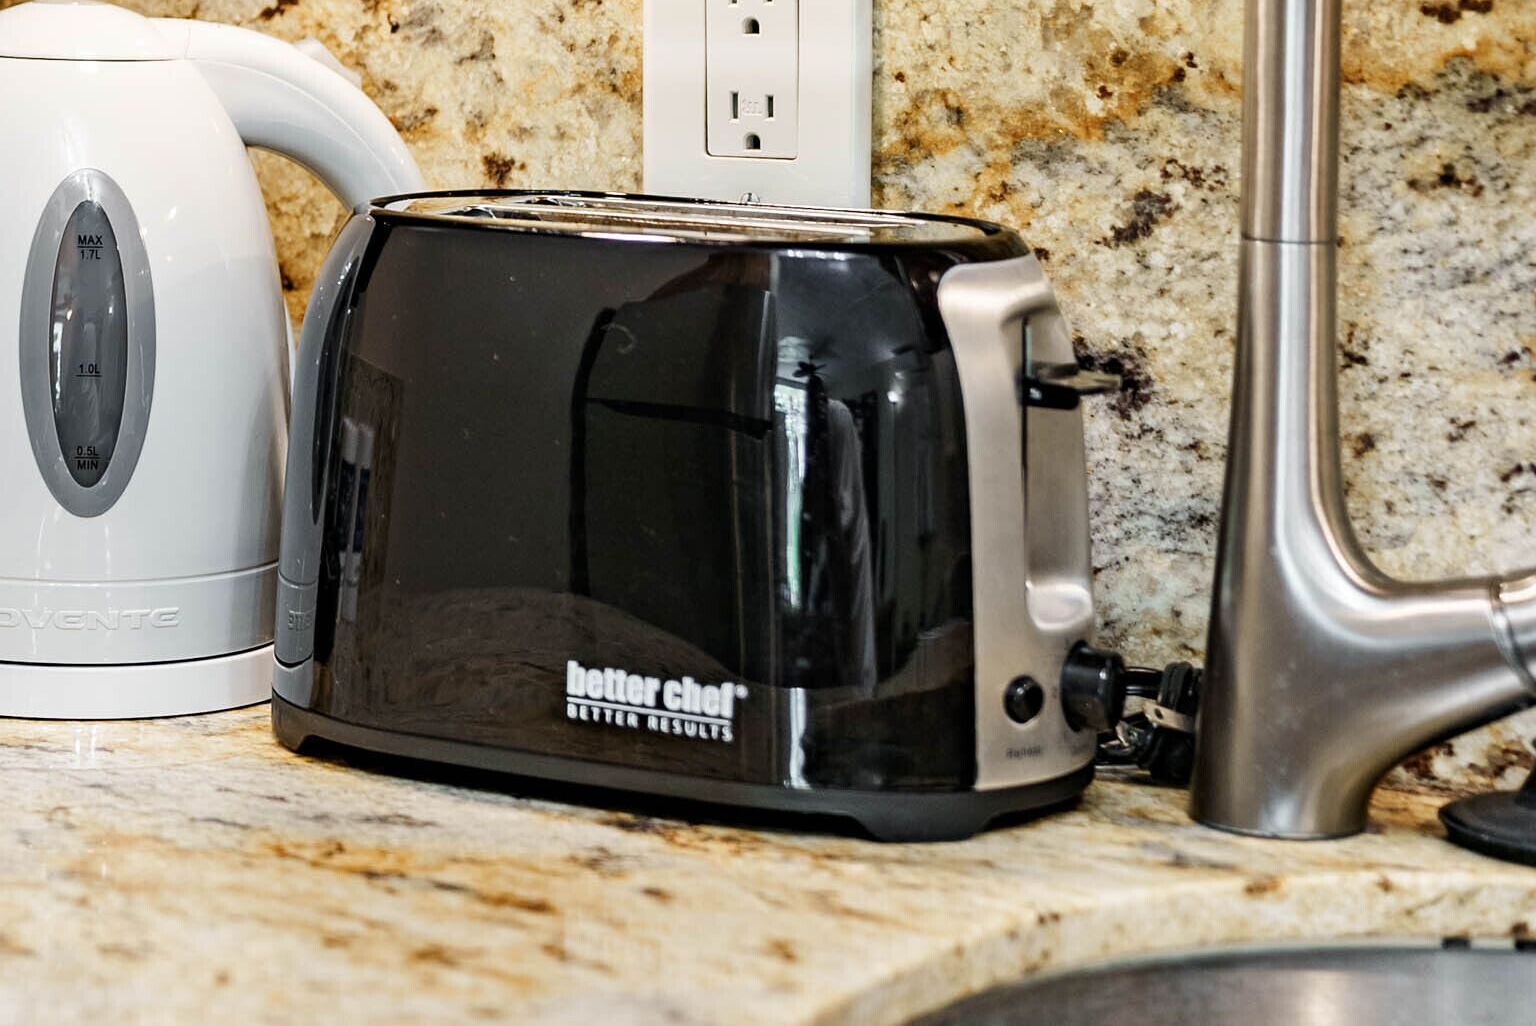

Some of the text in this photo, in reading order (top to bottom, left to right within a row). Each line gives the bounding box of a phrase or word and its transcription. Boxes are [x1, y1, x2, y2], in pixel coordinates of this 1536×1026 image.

[77, 235, 103, 246] MAX
[79, 249, 101, 261] 1.7L
[78, 363, 101, 374] 1.0L
[76, 446, 98, 457] 0.5L
[76, 460, 98, 471] MIN
[566, 660, 661, 708] better
[566, 702, 734, 743] BETTER RESULTS
